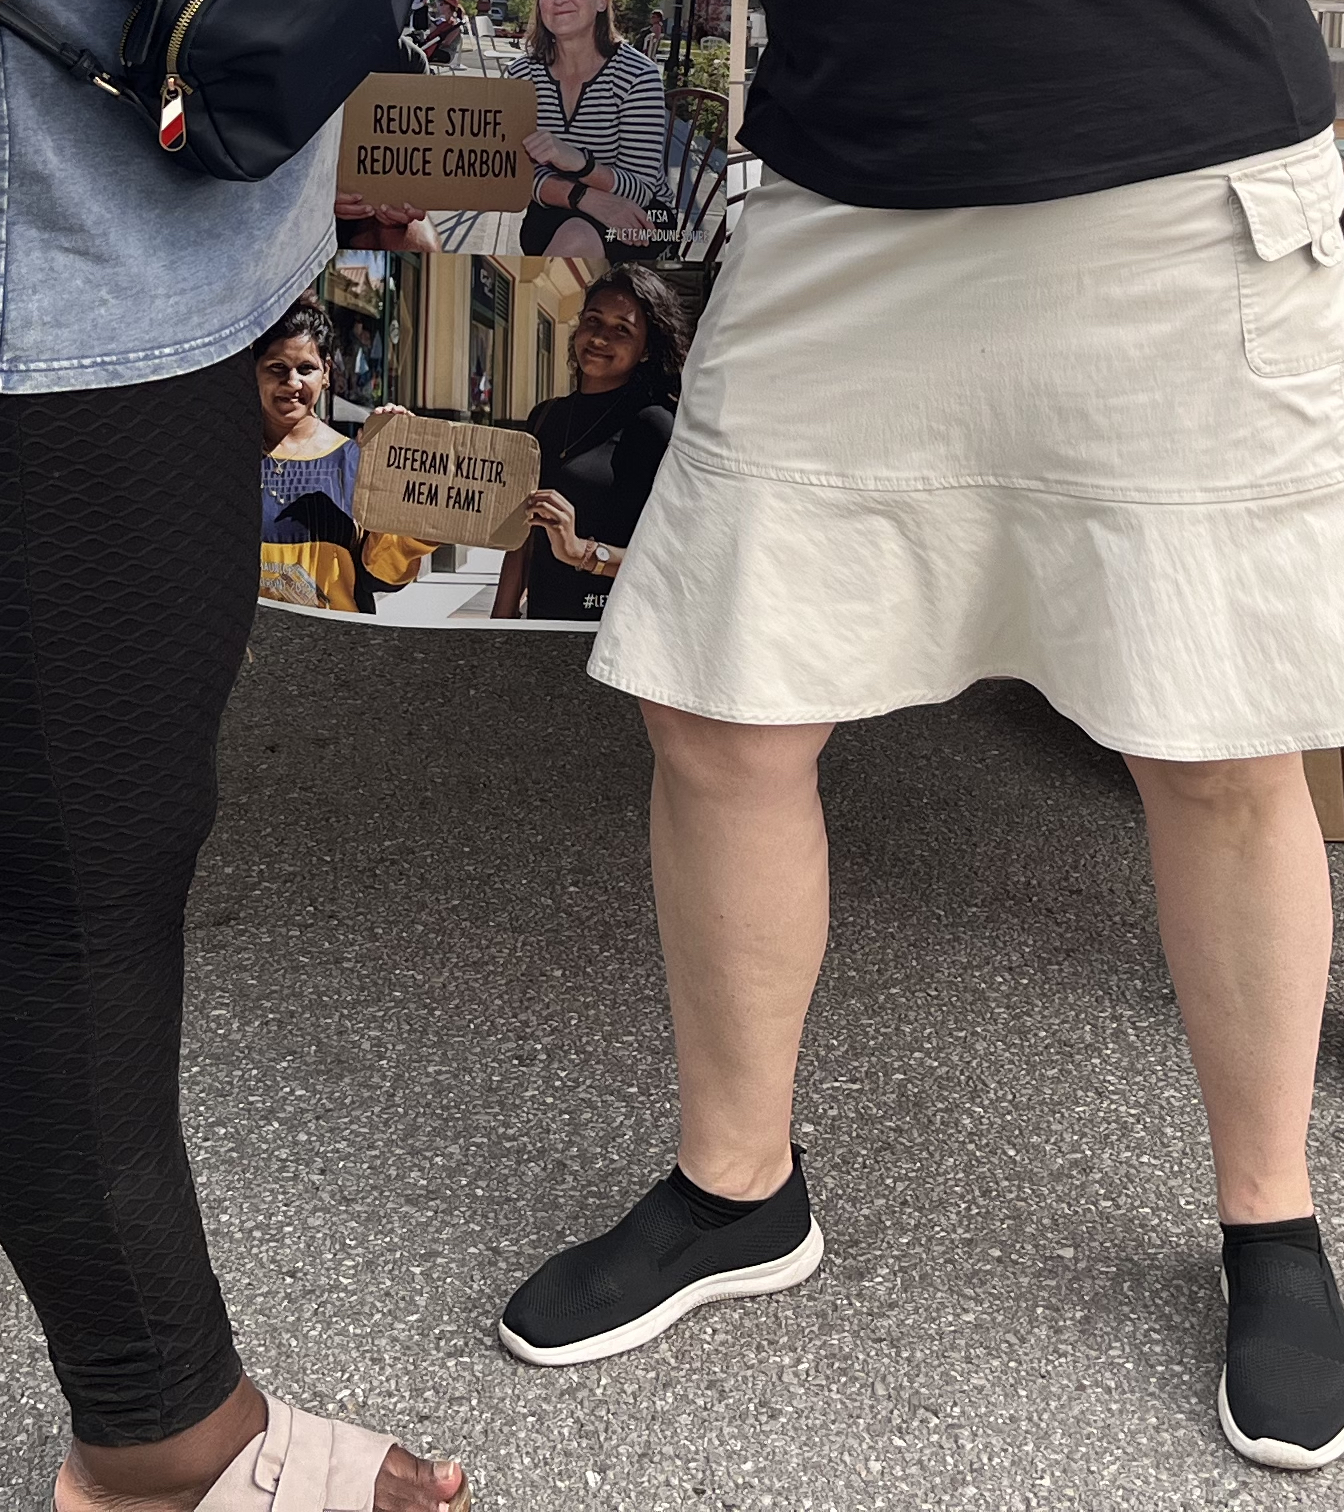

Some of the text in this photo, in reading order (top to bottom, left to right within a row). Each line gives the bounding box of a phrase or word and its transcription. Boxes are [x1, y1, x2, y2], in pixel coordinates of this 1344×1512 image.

[374, 104, 506, 143] REUSE STUFF,
[357, 145, 517, 178] REDUCE CARBON
[646, 209, 669, 223] ATSA
[386, 445, 507, 487] DIFERAN KILTIR,
[402, 479, 484, 513] MEM FAMI
